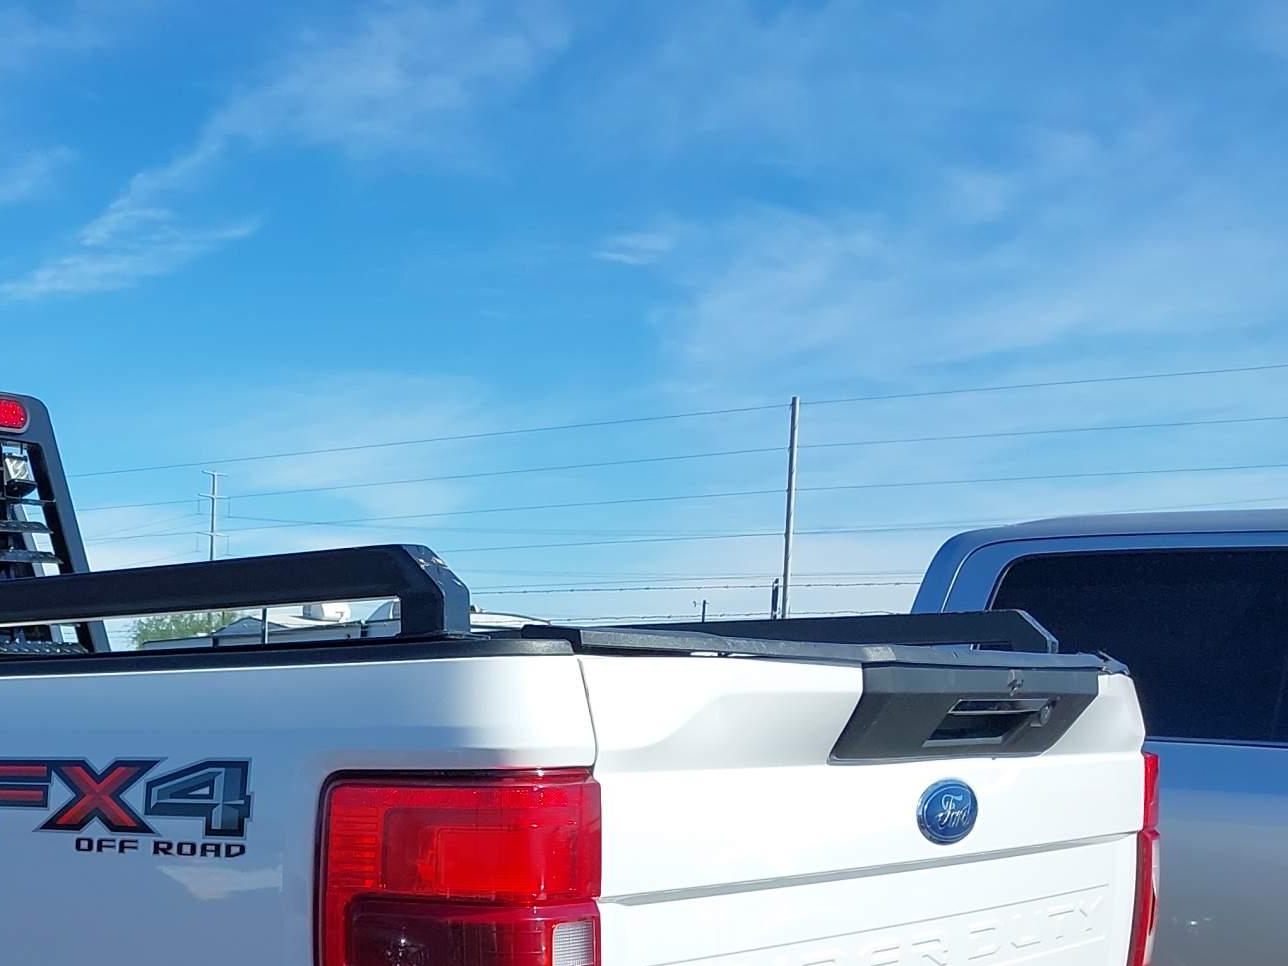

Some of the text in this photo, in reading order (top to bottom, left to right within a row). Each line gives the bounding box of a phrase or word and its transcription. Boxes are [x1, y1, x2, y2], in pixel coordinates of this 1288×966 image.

[935, 793, 971, 830] Ford
[74, 837, 247, 859] OFF ROAD
[967, 895, 1104, 962] DUTY
